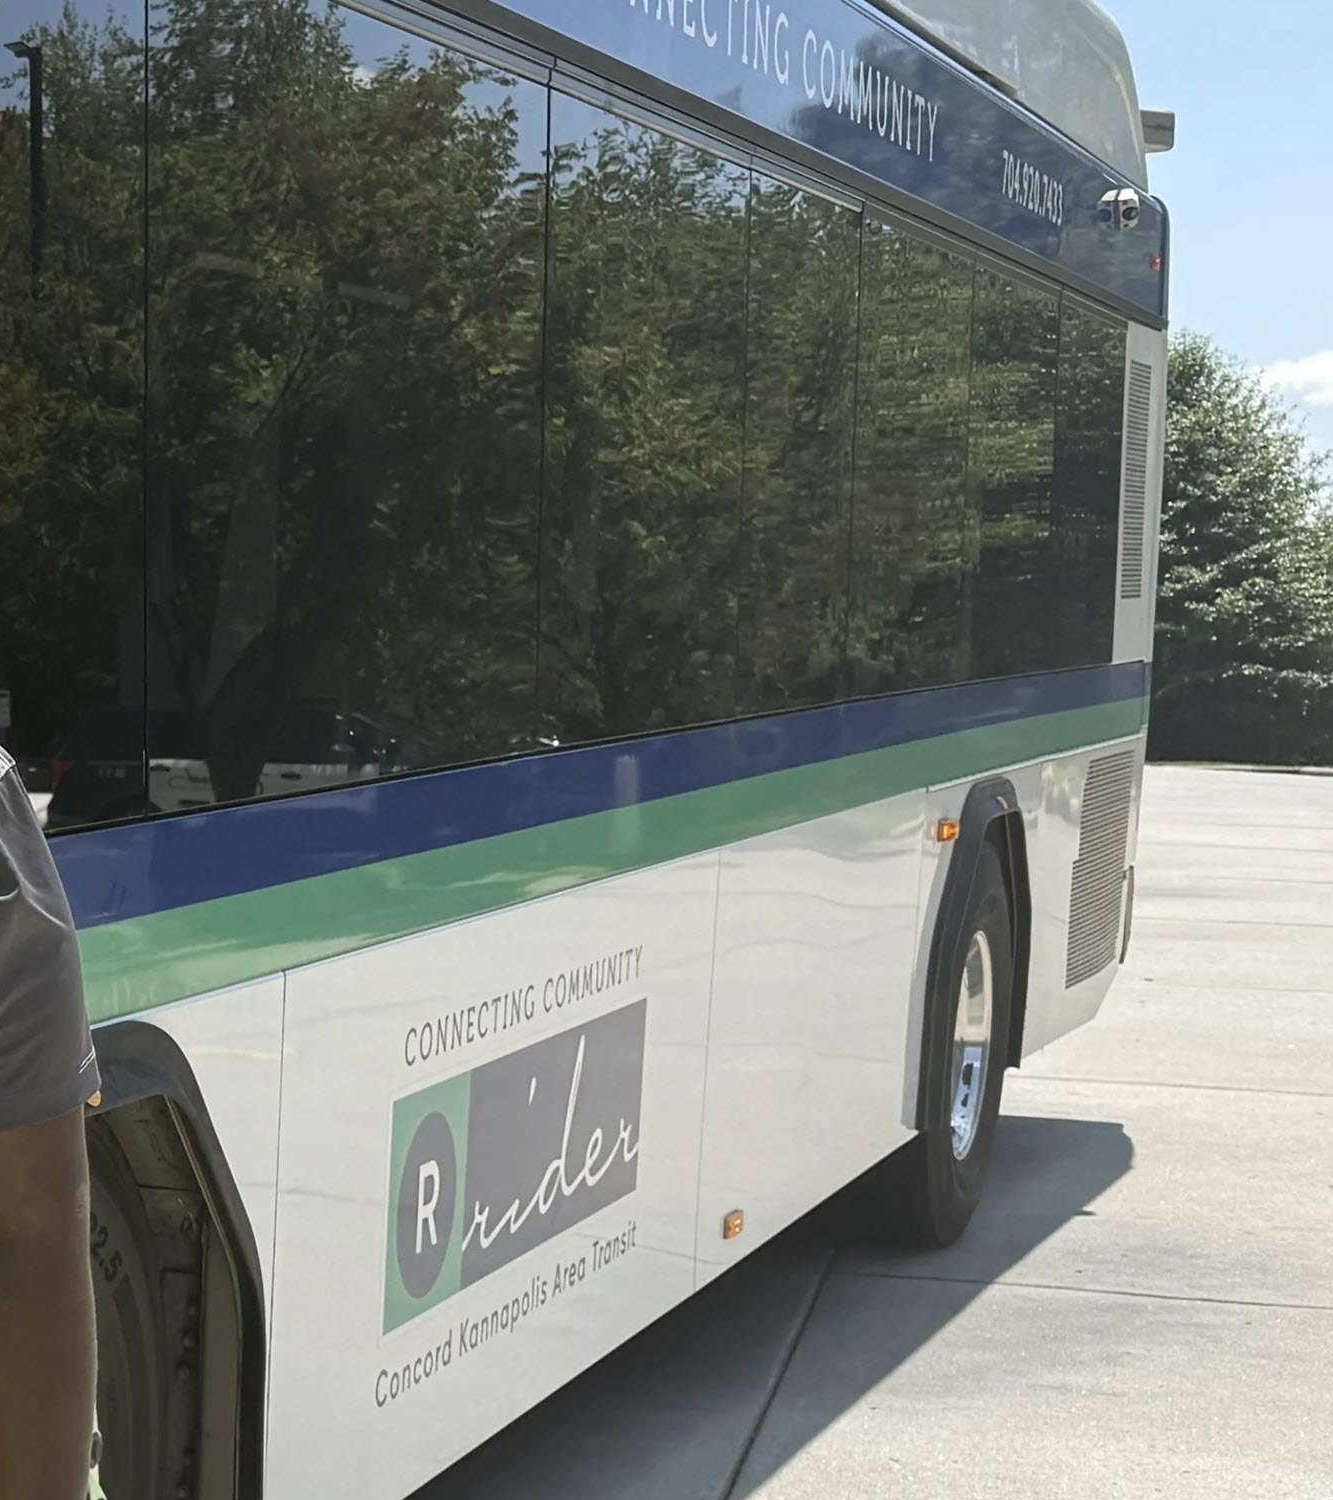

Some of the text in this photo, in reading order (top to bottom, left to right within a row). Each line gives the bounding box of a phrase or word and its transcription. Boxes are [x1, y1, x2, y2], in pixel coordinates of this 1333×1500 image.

[803, 29, 938, 163] COMMUNITY
[1002, 149, 1064, 227] 704.920.7433
[404, 945, 643, 1067] CONNECTING COMMUNITY
[414, 1158, 441, 1255] R
[461, 1034, 640, 1252] rider
[375, 1219, 637, 1408] Concord Kannapolis Area Transit
